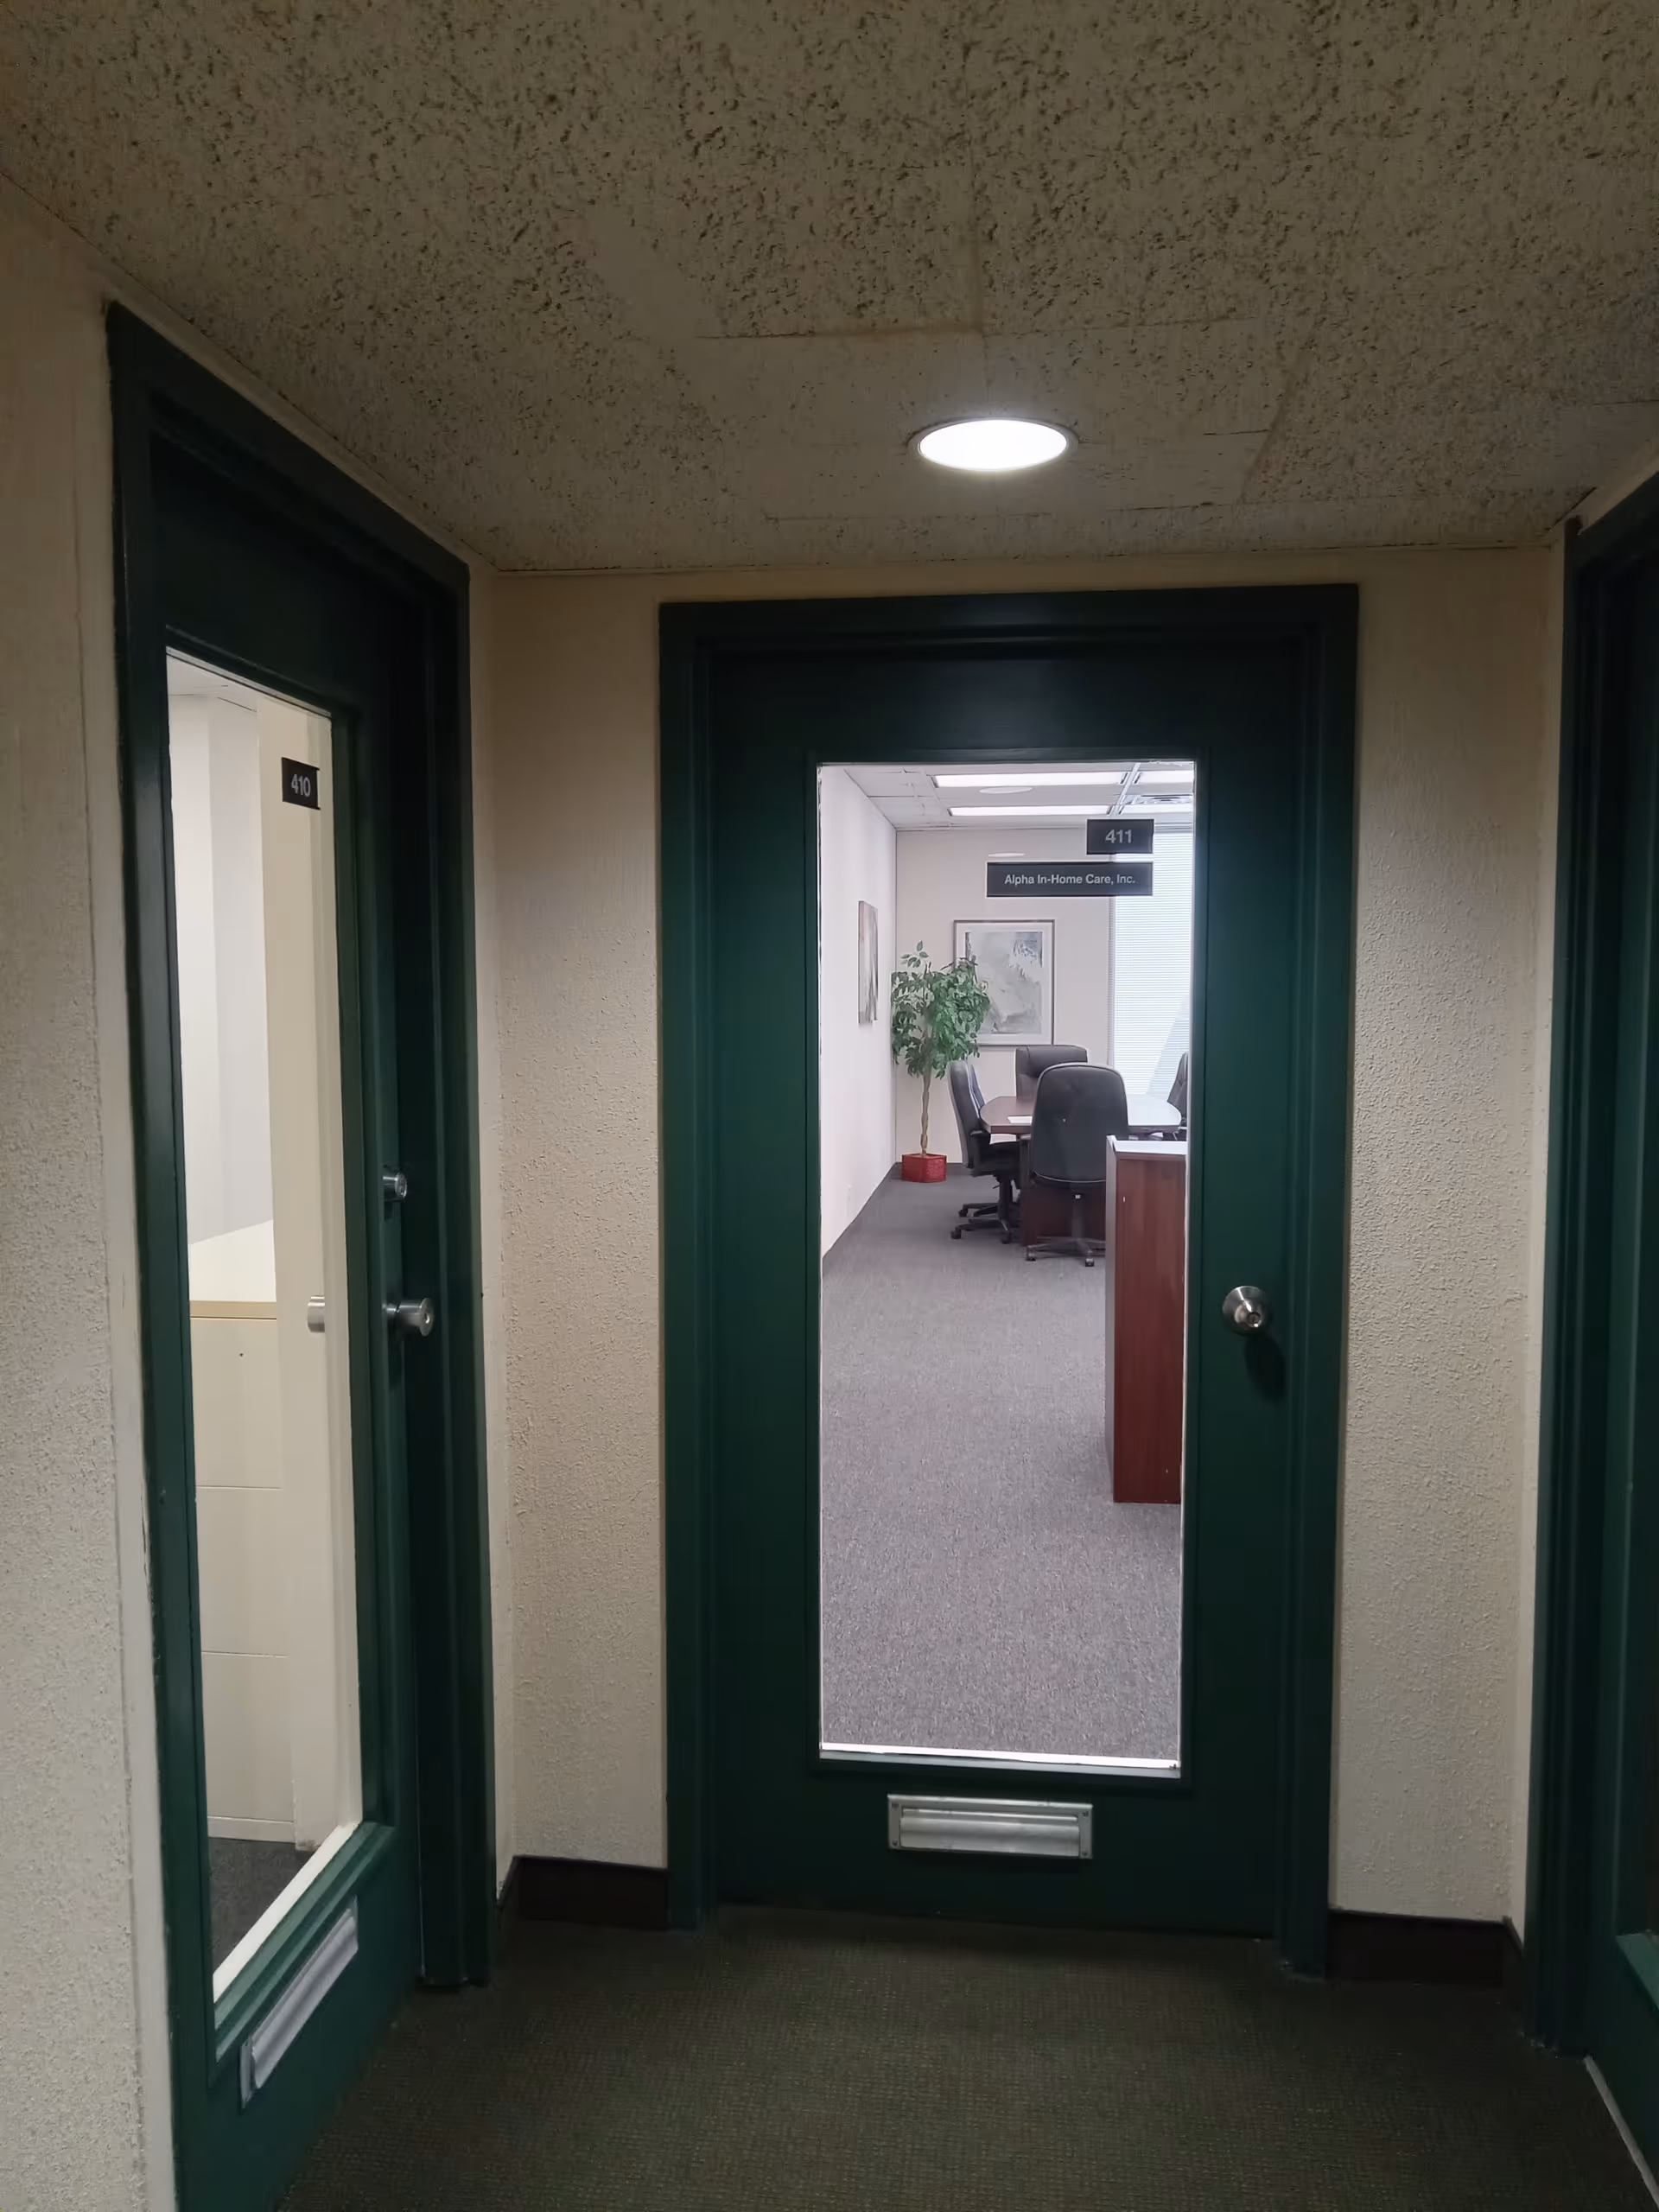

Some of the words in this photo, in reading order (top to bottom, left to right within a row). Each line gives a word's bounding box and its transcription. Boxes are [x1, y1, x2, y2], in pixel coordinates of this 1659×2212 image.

[291, 773, 311, 798] 410
[1105, 830, 1133, 843] 411
[1004, 874, 1035, 886] Alpha
[1037, 874, 1083, 885] In-Home
[1085, 874, 1114, 886] Care,
[1116, 874, 1136, 884] Inc.
